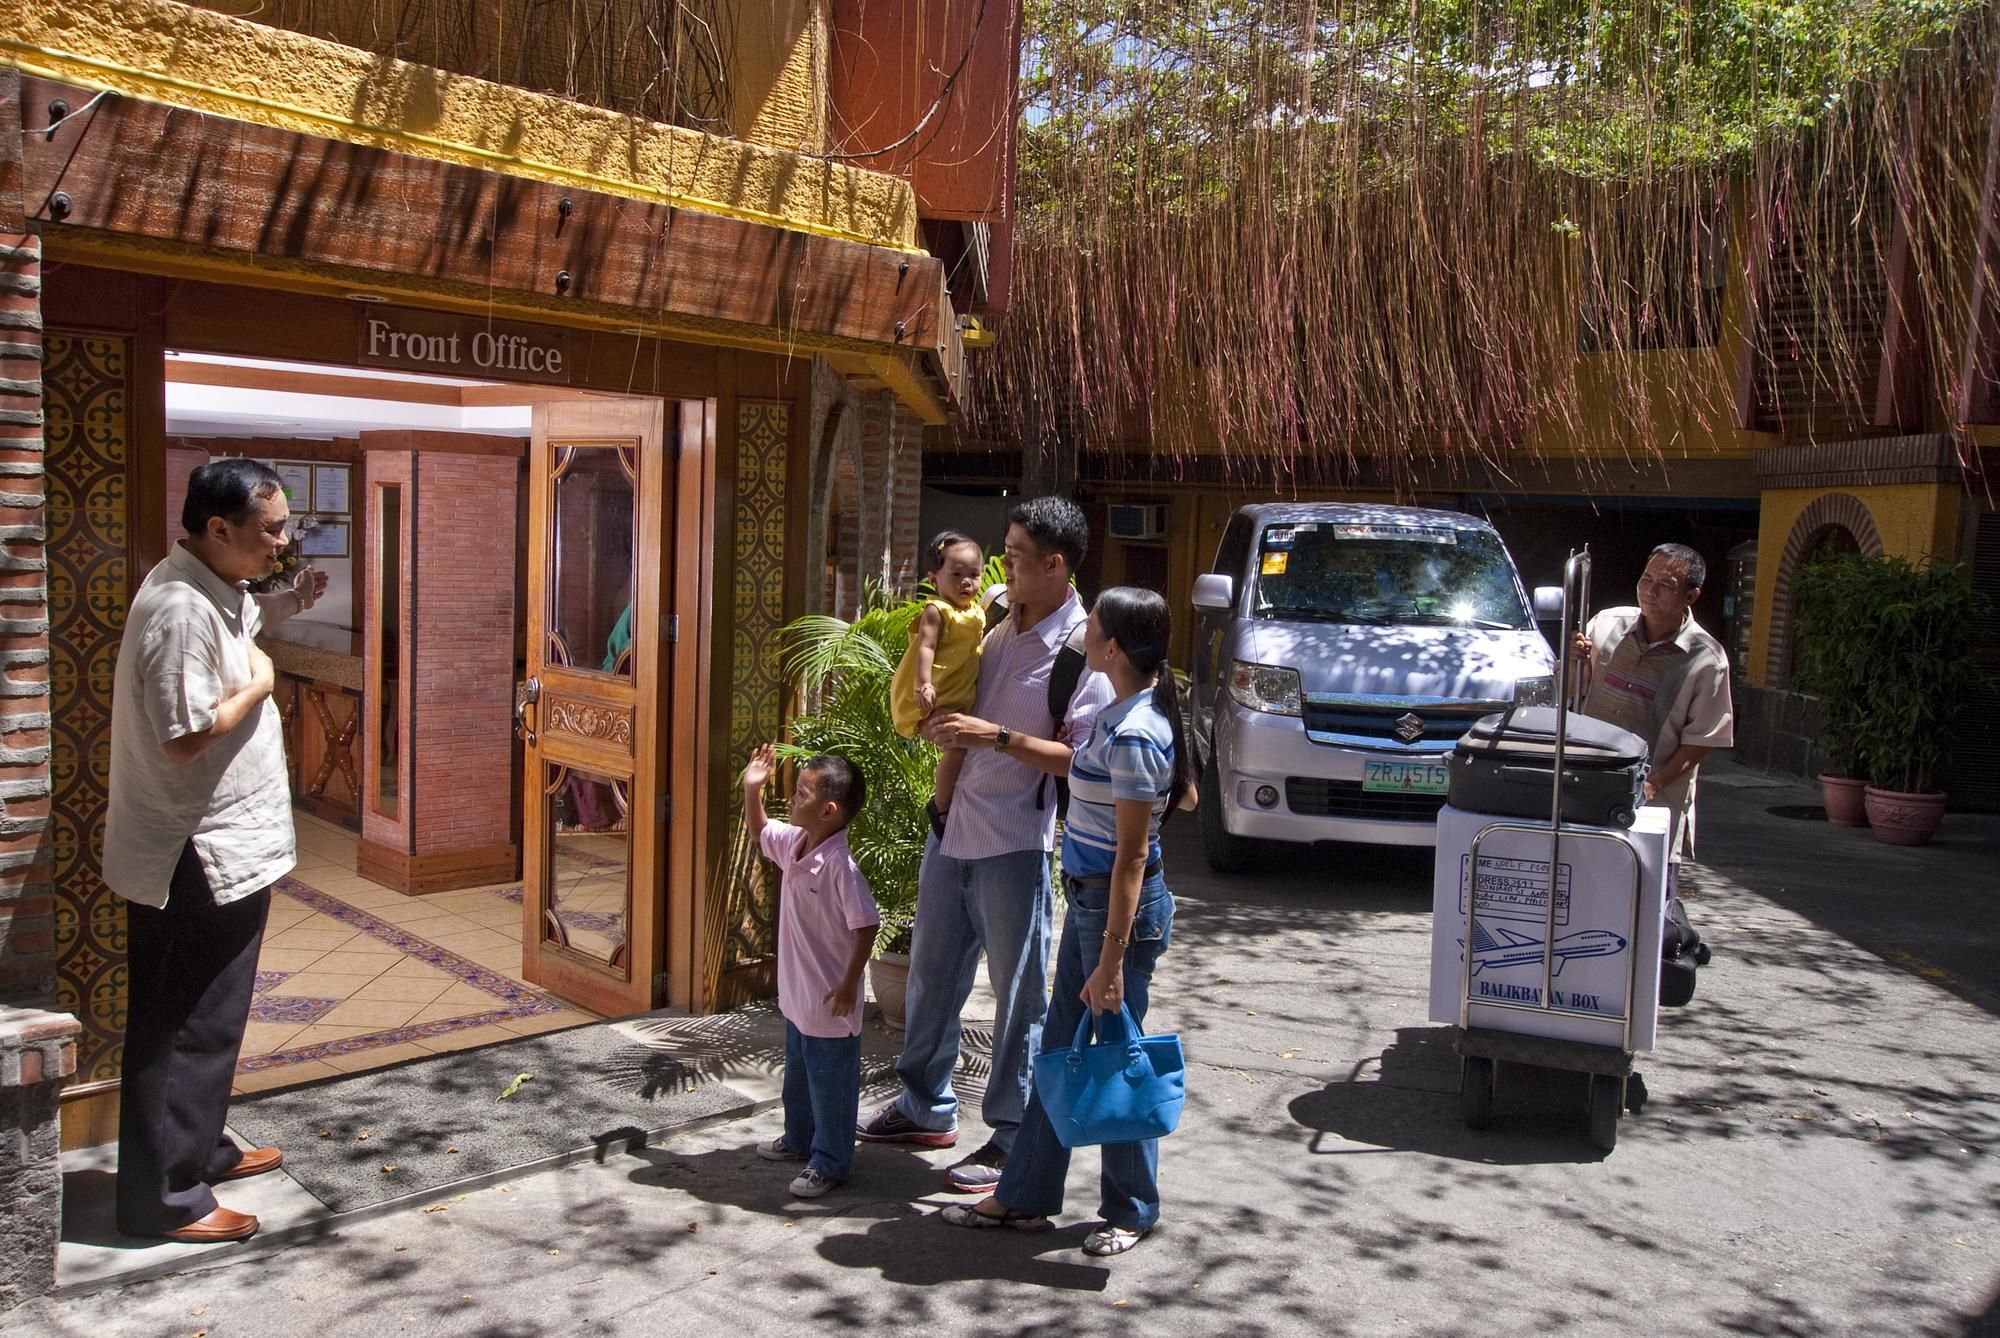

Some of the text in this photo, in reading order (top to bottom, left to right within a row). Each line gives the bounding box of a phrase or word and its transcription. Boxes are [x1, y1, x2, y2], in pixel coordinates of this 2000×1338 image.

[367, 319, 563, 374] Front Office
[1370, 764, 1446, 785] ZRJ 515
[1479, 980, 1601, 1010] BALIKBAAN BOX
